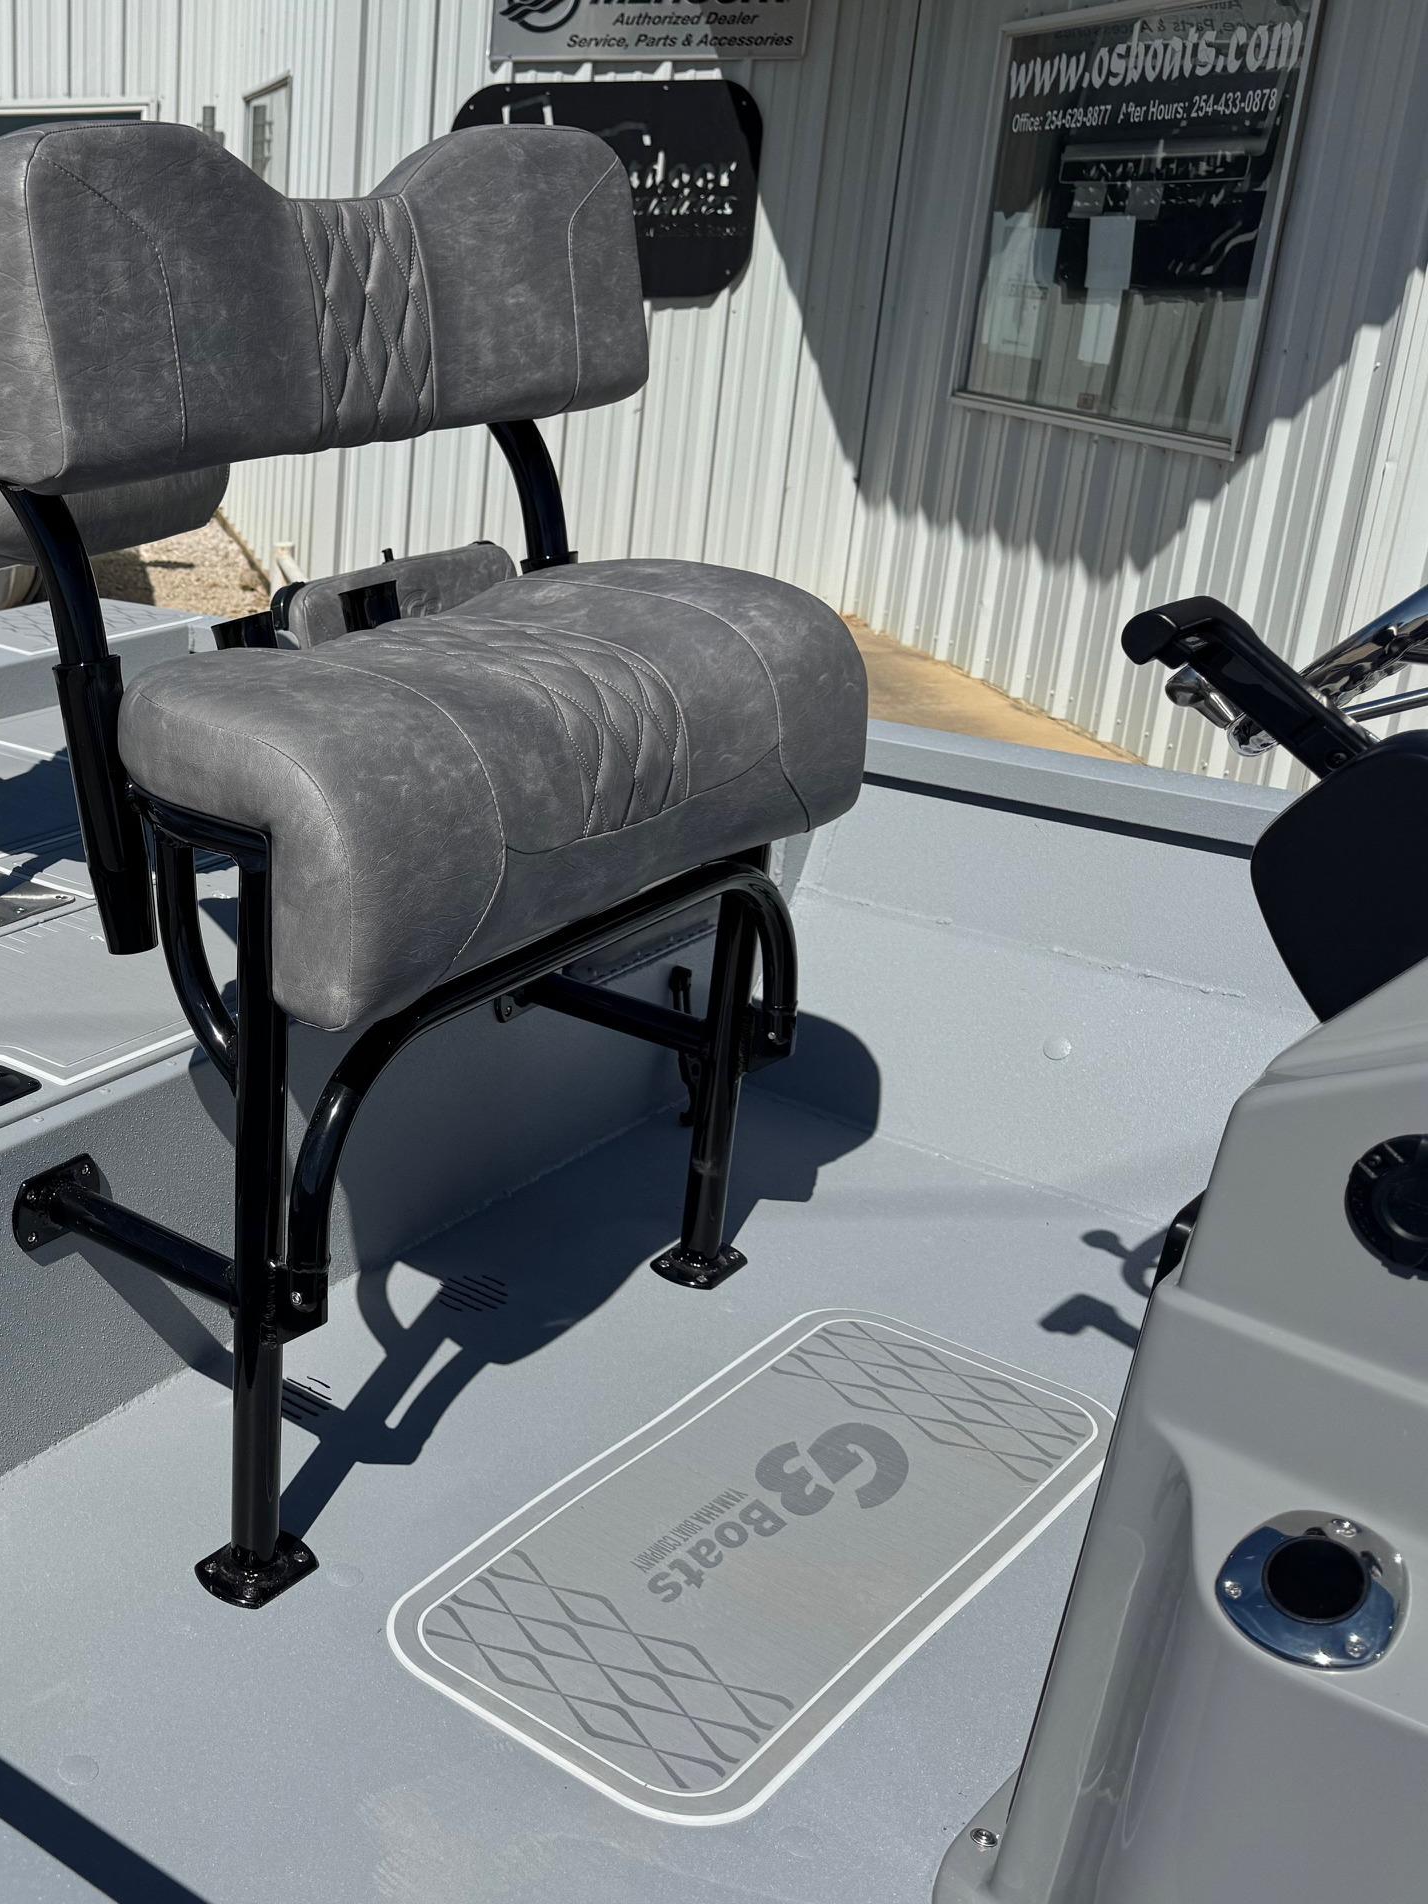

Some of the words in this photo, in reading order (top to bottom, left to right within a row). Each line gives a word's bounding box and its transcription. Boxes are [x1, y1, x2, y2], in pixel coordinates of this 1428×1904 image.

[612, 11, 702, 26] Authorized
[705, 11, 759, 26] Dealer
[567, 34, 630, 49] Service,
[635, 33, 678, 48] Parts
[682, 33, 693, 47] &
[696, 33, 794, 48] Accessories
[1012, 112, 1043, 133] Office:
[1044, 104, 1112, 131] 254-629-8877
[1148, 99, 1188, 121] Hours:
[1190, 88, 1278, 118] 254-433-0878
[754, 1421, 910, 1516] G3
[690, 1488, 749, 1531] YAMAHA
[670, 1519, 700, 1544] BOAT
[629, 1535, 679, 1573] COMPANY
[647, 1498, 788, 1603] Boats
